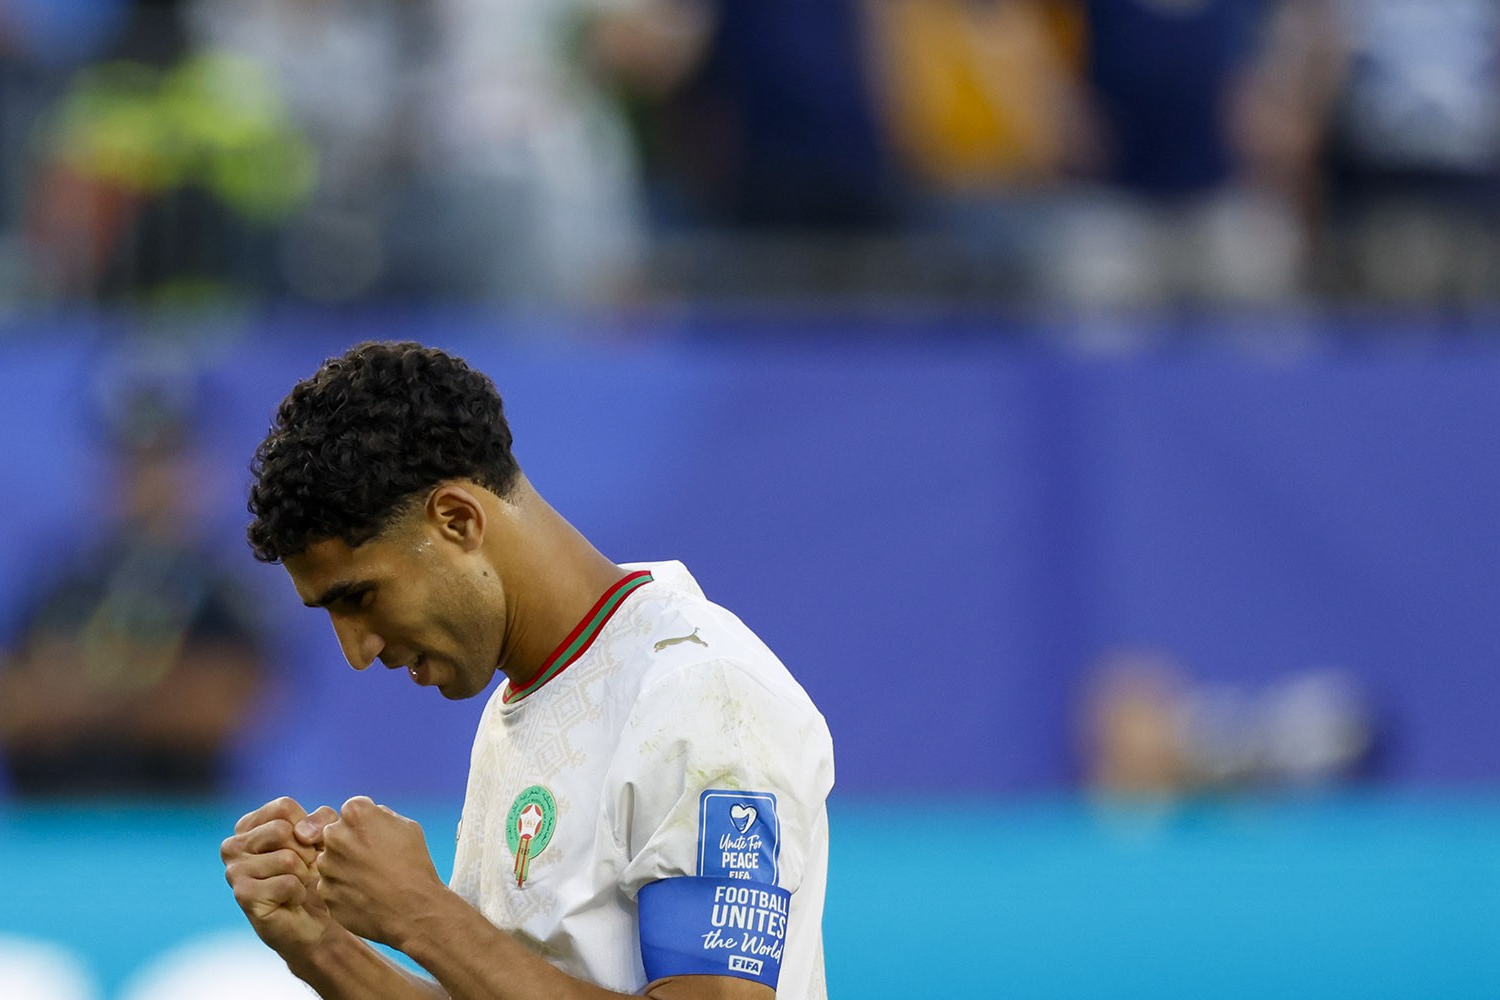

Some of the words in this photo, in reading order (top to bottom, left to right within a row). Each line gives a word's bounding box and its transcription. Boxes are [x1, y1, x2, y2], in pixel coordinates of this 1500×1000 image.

[720, 834, 746, 852] Unite
[747, 834, 762, 850] For
[722, 852, 759, 869] PEACE
[729, 871, 750, 880] FIFA
[714, 886, 787, 916] FOOTBALL
[711, 904, 786, 939] UNITES
[701, 929, 738, 950] the
[741, 932, 784, 964] World
[732, 958, 760, 972] FIFA
